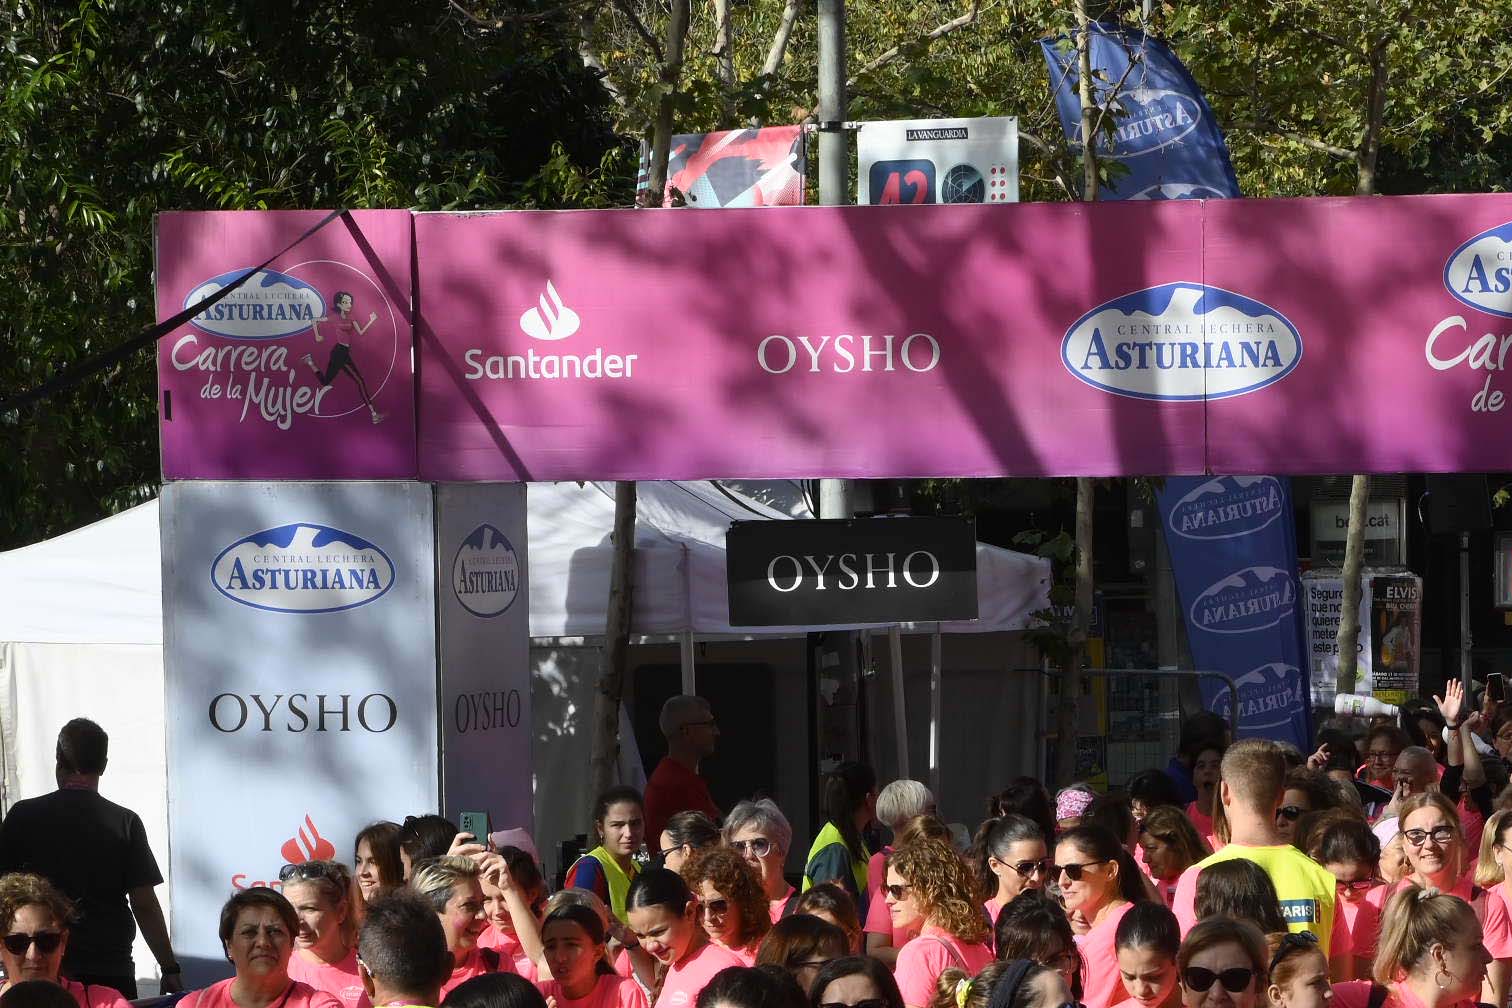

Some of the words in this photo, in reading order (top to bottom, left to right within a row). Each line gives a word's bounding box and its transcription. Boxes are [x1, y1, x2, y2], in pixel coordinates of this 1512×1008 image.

[1117, 324, 1192, 336] CENTRAL
[171, 335, 288, 372] Carrera
[464, 348, 638, 380] Santander
[757, 333, 941, 374] OYSHO
[1081, 327, 1283, 370] ASTURIANA
[200, 374, 222, 399] de
[227, 371, 242, 400] la
[240, 369, 333, 430] Mujer
[1471, 379, 1505, 412] de
[226, 556, 382, 591] ASTURIANA
[253, 554, 311, 563] CENTRAL
[317, 554, 375, 563] LECHERA
[458, 555, 516, 595] ASTURIANA
[767, 550, 940, 592] OYSHO
[1311, 604, 1329, 615] que
[1386, 586, 1418, 600] ELVIS
[1312, 642, 1332, 653] este
[208, 692, 398, 732] OYSHO
[455, 689, 521, 733] OYSHO
[1280, 905, 1313, 918] ARIS
